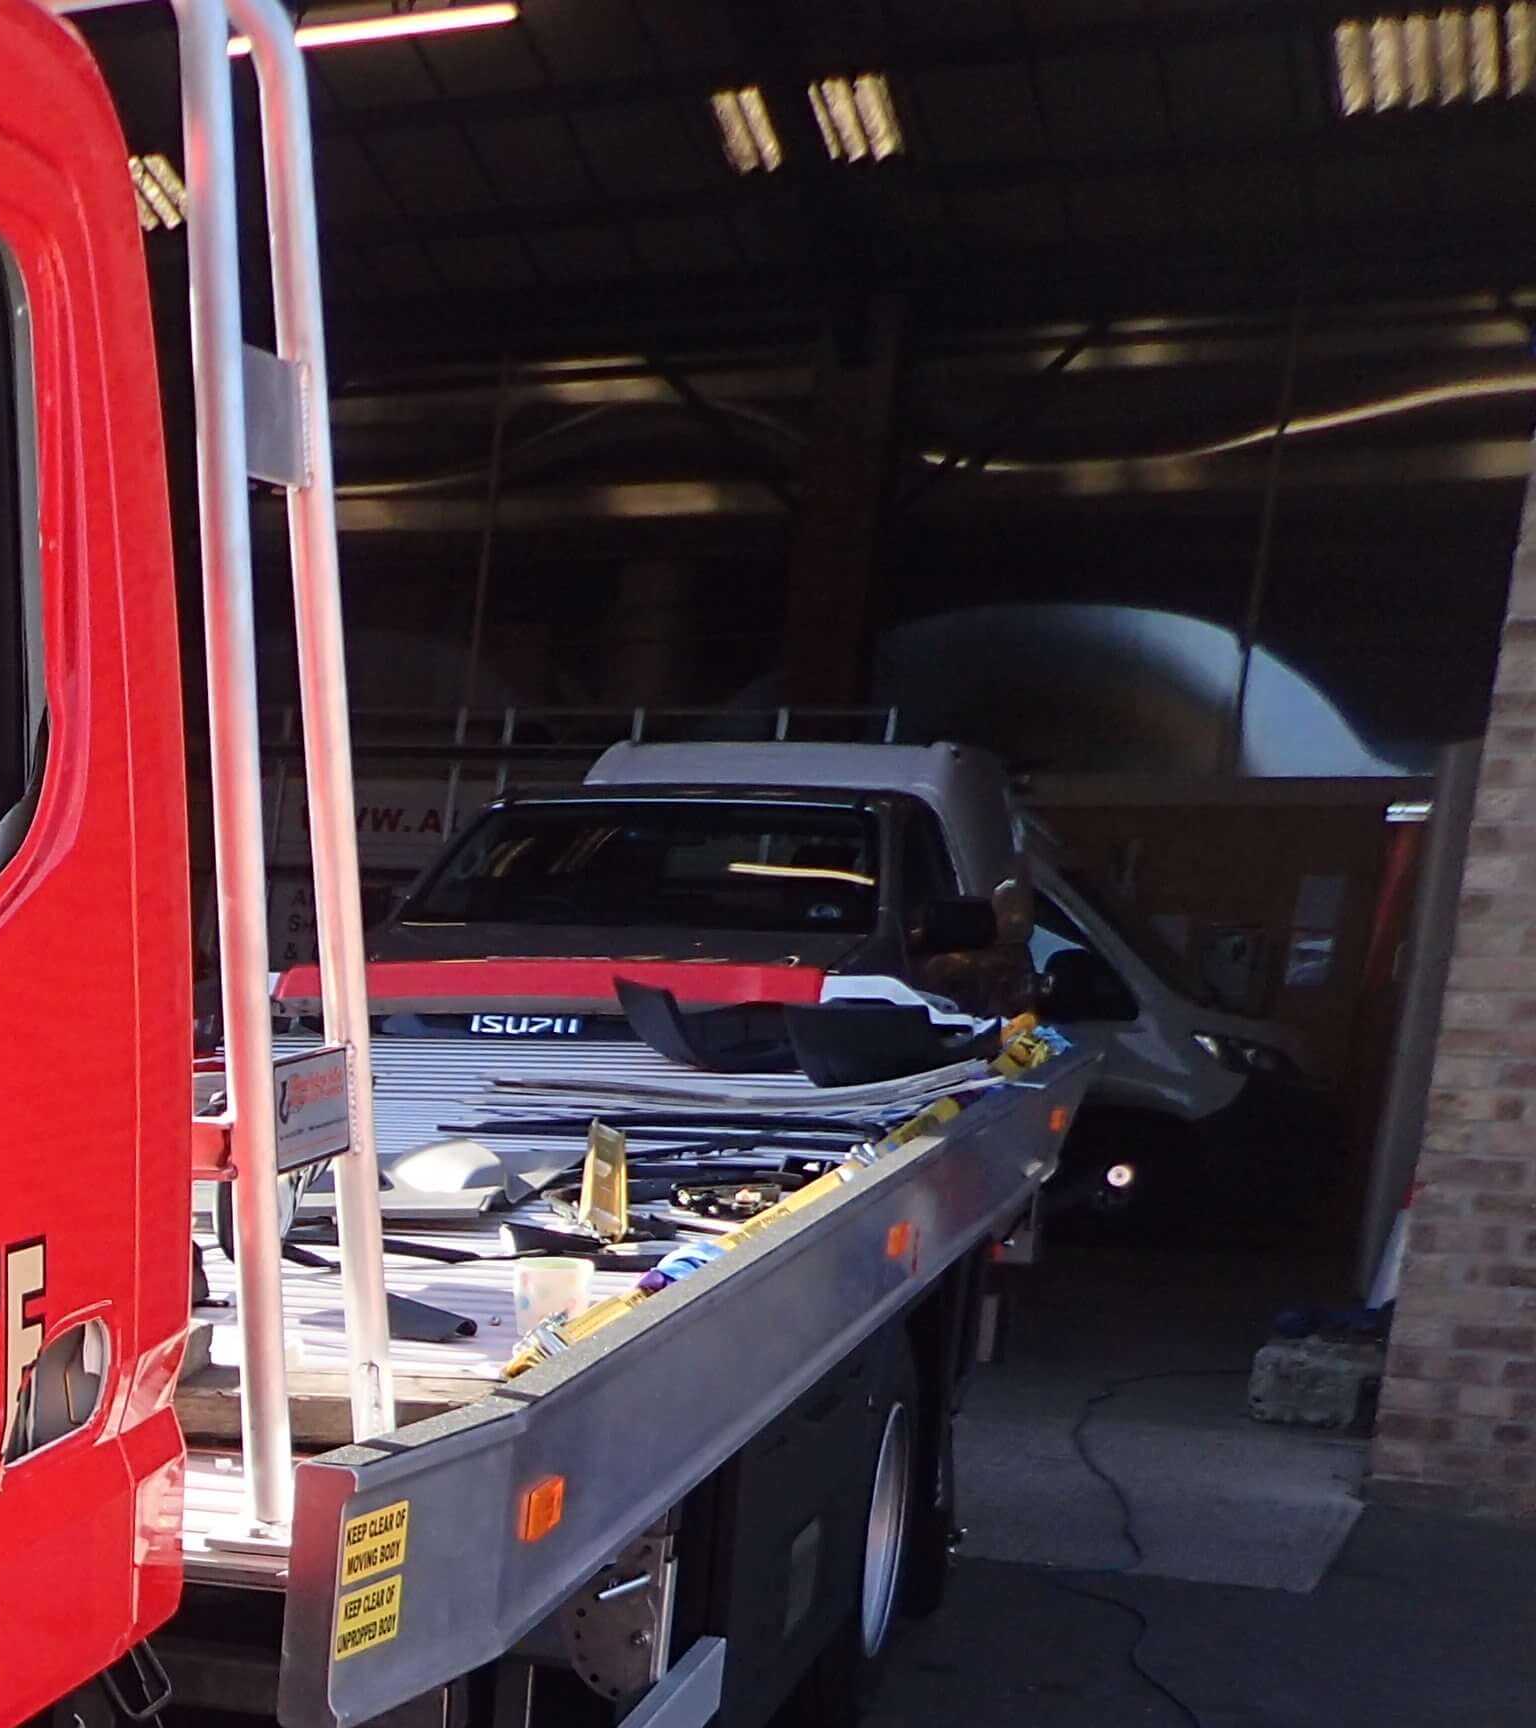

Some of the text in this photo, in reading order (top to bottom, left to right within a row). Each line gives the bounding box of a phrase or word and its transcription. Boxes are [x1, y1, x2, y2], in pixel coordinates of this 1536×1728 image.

[471, 1014, 578, 1034] ISUZU
[346, 1508, 407, 1547] KEEP CLEAR OF
[347, 1539, 401, 1576] MOVING BODY
[344, 1583, 396, 1621] KEEP CLEAR OF
[337, 1613, 396, 1654] UNPROPPED BODY
